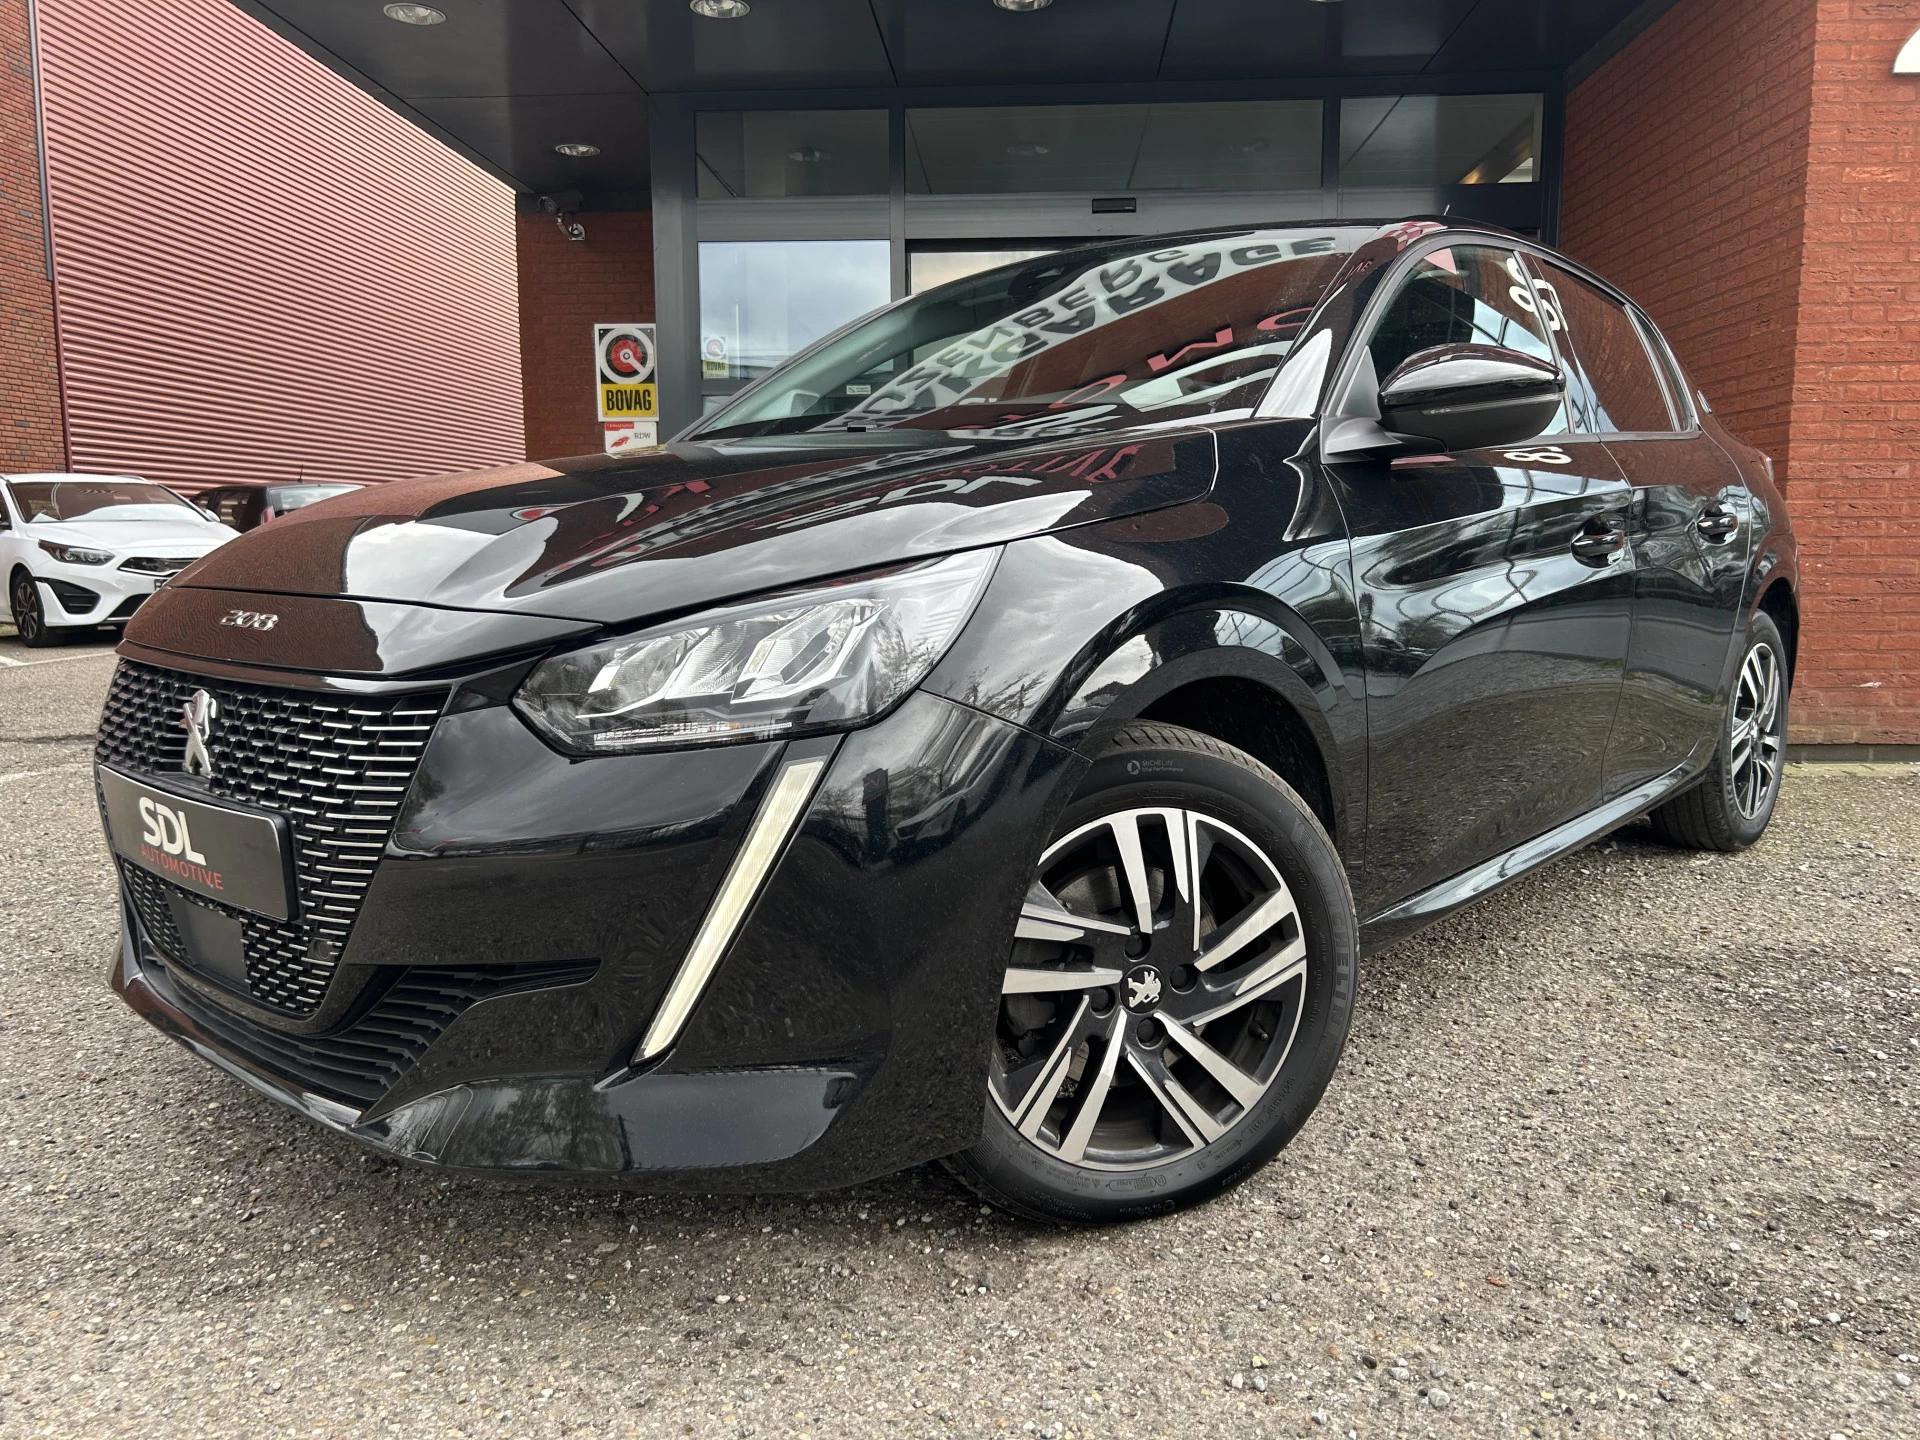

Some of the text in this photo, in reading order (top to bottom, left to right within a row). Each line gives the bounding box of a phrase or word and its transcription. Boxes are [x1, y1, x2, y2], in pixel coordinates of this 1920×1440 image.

[606, 389, 652, 411] BOVAG
[634, 432, 651, 440] RDW
[220, 609, 279, 631] 208
[139, 796, 207, 866] SDL
[141, 843, 224, 890] AUTOMOTIVE
[1318, 874, 1349, 1026] MICHELIN
